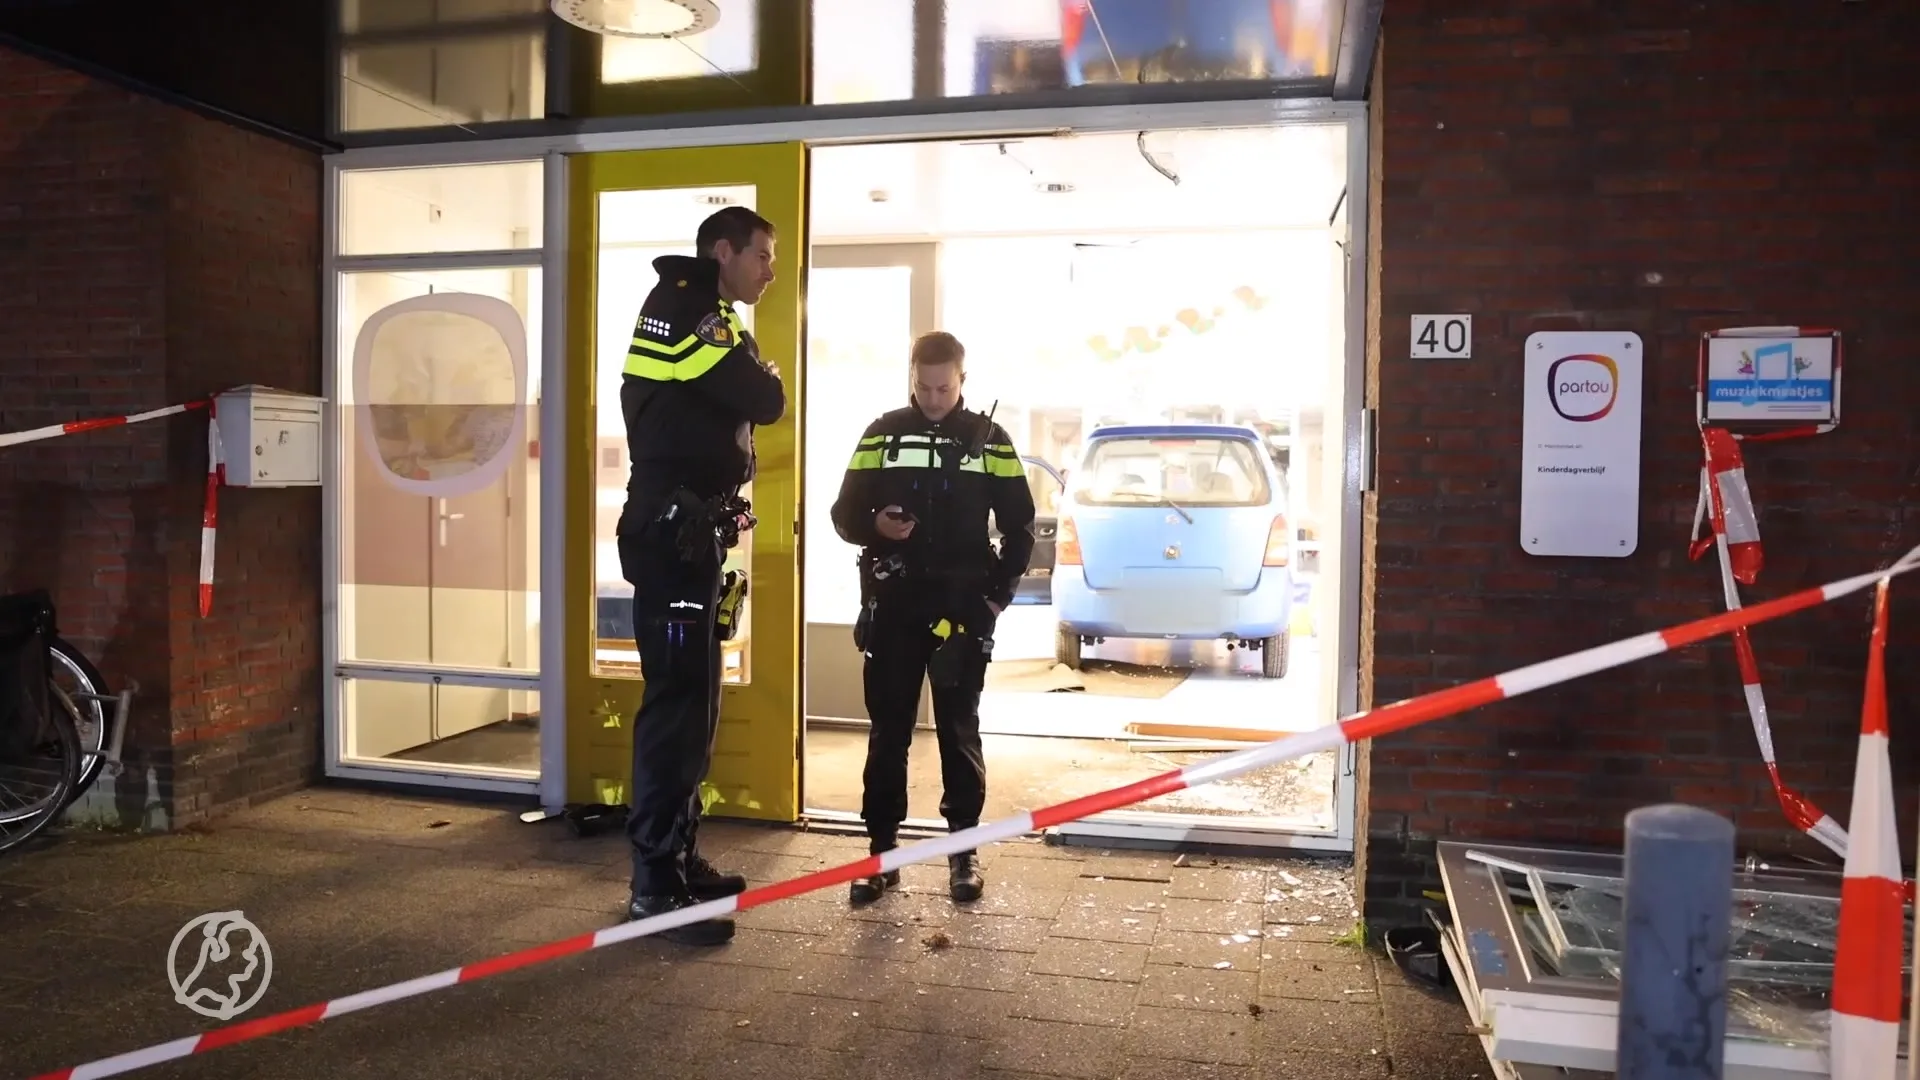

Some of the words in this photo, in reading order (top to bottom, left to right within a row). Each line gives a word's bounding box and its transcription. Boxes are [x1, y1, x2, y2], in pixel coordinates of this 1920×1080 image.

[1416, 319, 1466, 353] 40
[1560, 380, 1609, 396] partou
[1715, 385, 1824, 399] muziekmaatjes
[1537, 466, 1606, 476] Kinderdagverblijf
